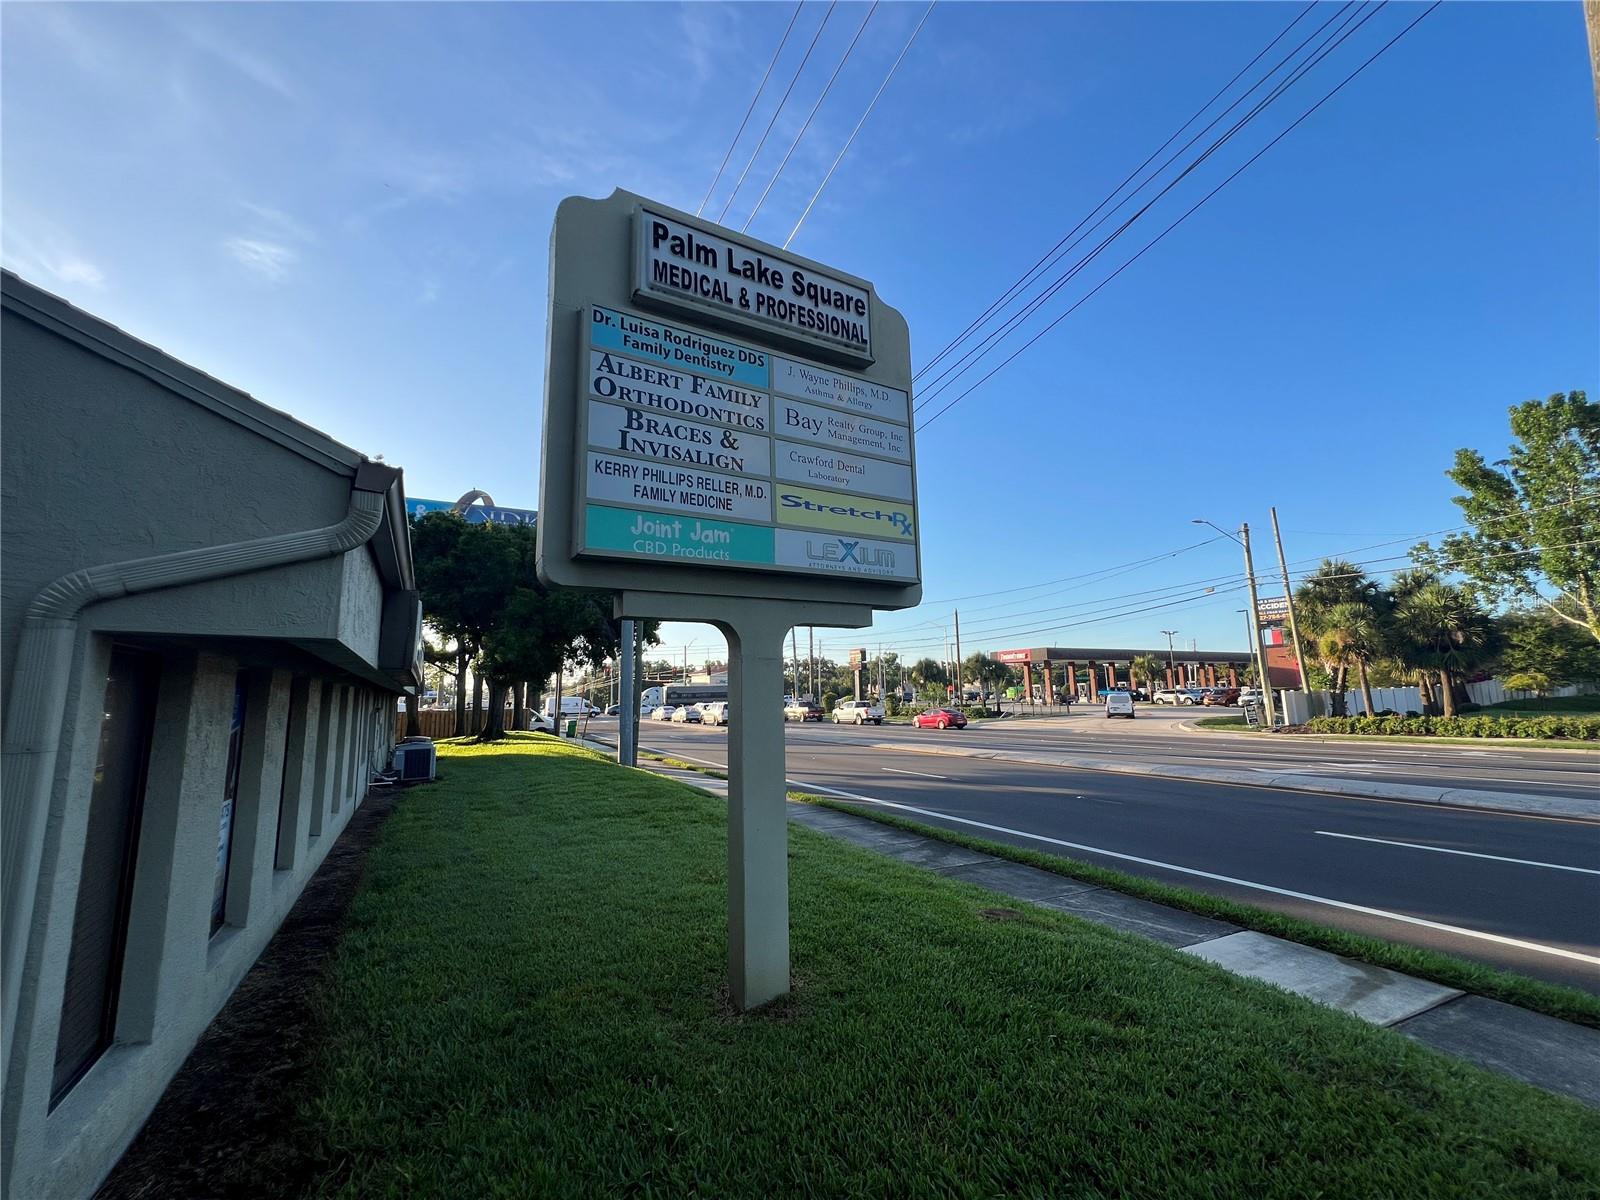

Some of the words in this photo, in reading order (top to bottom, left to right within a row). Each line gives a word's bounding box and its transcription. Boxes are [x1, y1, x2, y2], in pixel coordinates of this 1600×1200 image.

[652, 220, 718, 269] Palm
[727, 246, 785, 290] Lake
[792, 270, 866, 316] Square
[653, 258, 733, 305] MEDICAL
[739, 287, 750, 310] &
[756, 292, 868, 344] PROFESSIONAL
[592, 309, 616, 327] Dr.
[620, 317, 659, 339] Luisa
[663, 329, 735, 359] Rodriguez
[738, 350, 765, 367] DDS
[623, 335, 671, 360] Family
[674, 350, 735, 376] Dentistry
[596, 352, 683, 390] ALBERT
[690, 375, 762, 408] FAMILY
[799, 368, 830, 386] Wayne
[870, 388, 892, 402] M.D.
[593, 376, 765, 430] ORTHODONTICS
[804, 386, 834, 400] Asthma
[846, 396, 873, 409] Allergy
[624, 407, 712, 445] BRACES
[719, 429, 739, 450] &
[784, 407, 823, 435] Bay
[827, 416, 856, 431] Realty
[618, 429, 744, 472] INVISALIGN
[827, 429, 886, 450] Management,
[594, 459, 639, 478] KERRY
[642, 467, 694, 488] PHILLIPS
[697, 476, 742, 498] RELLER,
[745, 484, 767, 499] M.D.
[789, 450, 834, 469] Crawford
[837, 459, 865, 475] Dental
[808, 469, 850, 486] Laboratory
[633, 484, 676, 503] FAMILY
[680, 491, 733, 511] MEDICINE
[630, 515, 682, 538] Joint
[690, 522, 730, 544] Jam
[633, 539, 667, 555] CBD
[672, 543, 730, 561] Products
